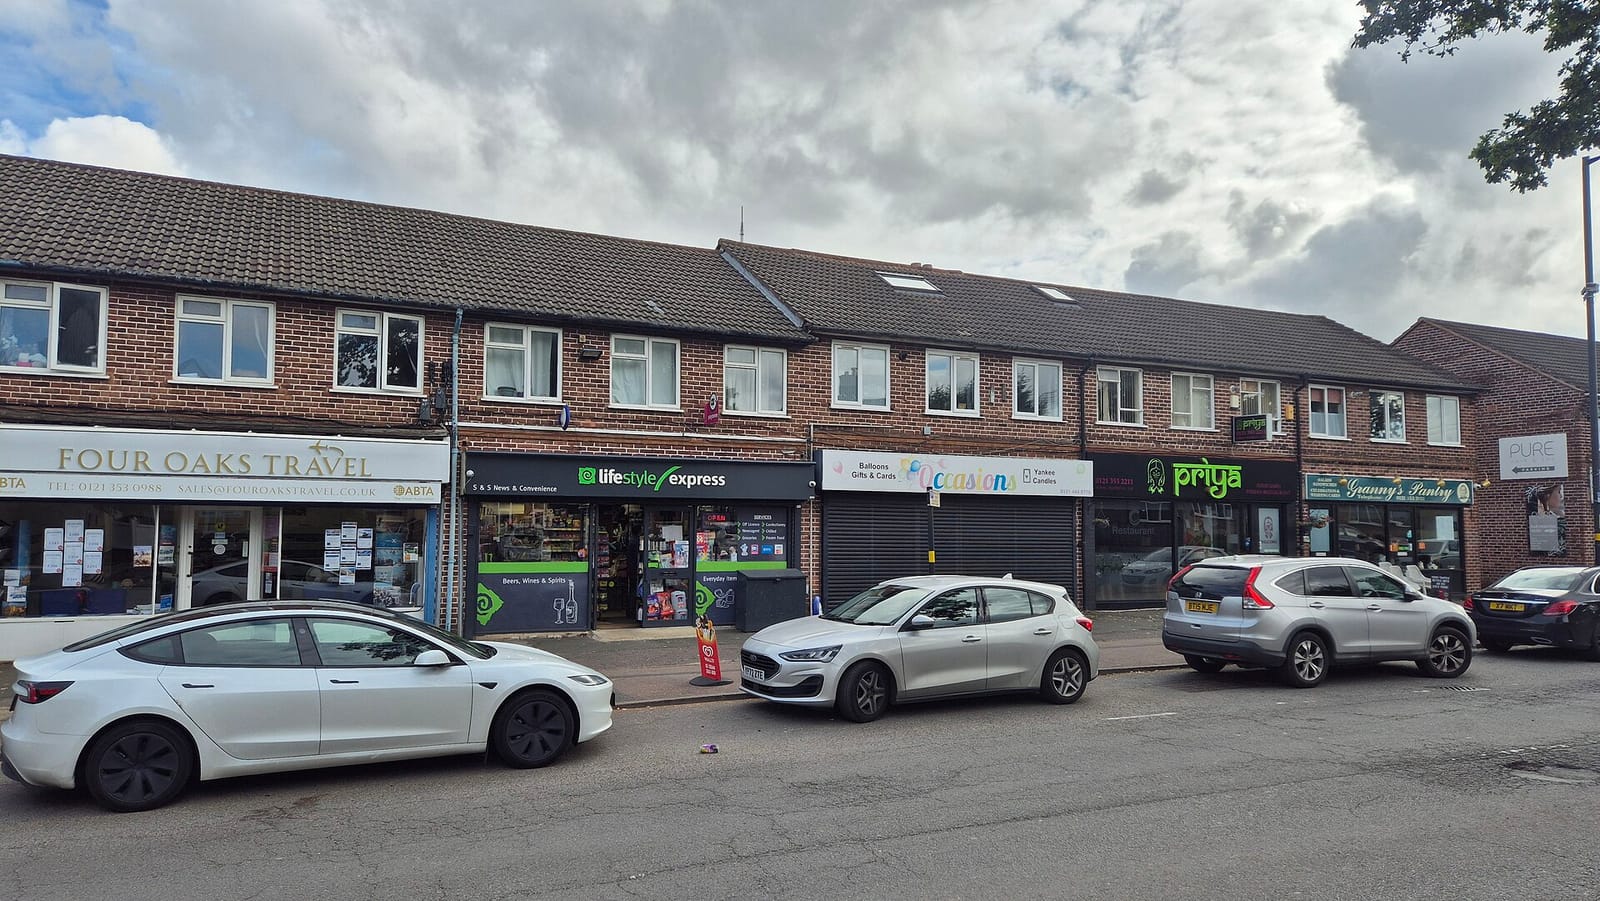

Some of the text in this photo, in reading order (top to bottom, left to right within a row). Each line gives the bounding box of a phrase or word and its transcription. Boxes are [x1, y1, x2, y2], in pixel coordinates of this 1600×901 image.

[1509, 441, 1555, 458] PURE
[58, 448, 373, 477] FOUR OAKS TRAVEL
[858, 462, 889, 471] Balloons
[599, 468, 726, 489] lifestyle express
[851, 471, 897, 480] Gifts & Cards
[918, 464, 1017, 491] Occasions
[1033, 468, 1056, 477] Yankee
[1172, 457, 1242, 499] priya
[0, 477, 26, 489] BTA
[48, 481, 163, 493] TEL: 0121 353 0988
[1032, 477, 1057, 485] Candles
[178, 484, 377, 497] SALES@FOUROAKSTRAVEL.CO.UK
[404, 487, 434, 497] ABTA
[519, 485, 558, 493] Convenience
[1346, 478, 1456, 502] Granny's Pantry
[1112, 526, 1154, 535] Restaurant
[502, 577, 521, 585] Beers,
[547, 577, 566, 585] Spirits
